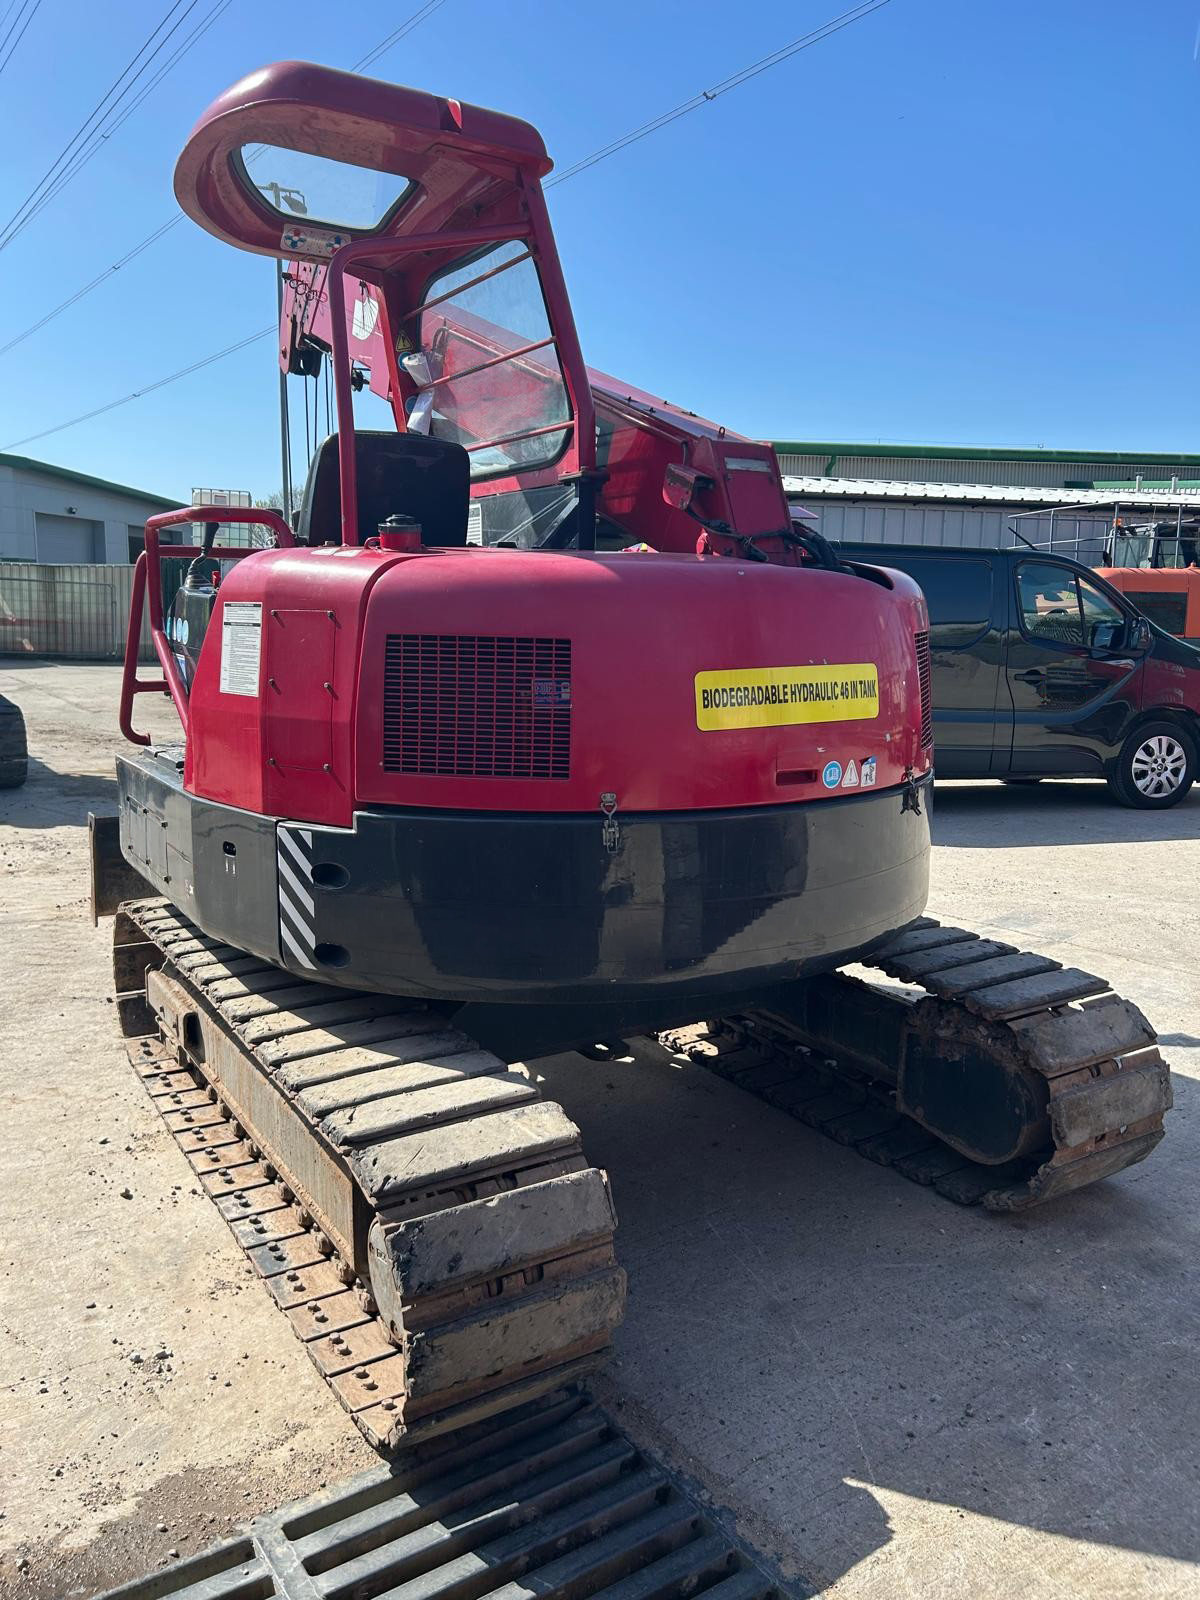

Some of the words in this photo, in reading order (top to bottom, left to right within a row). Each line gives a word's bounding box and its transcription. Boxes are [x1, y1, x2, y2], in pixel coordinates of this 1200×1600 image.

[702, 684, 789, 709] BIODEGRADABLE
[790, 681, 839, 703] HYDRAULIC
[840, 682, 849, 699] 46
[850, 680, 858, 699] IN
[859, 679, 877, 698] TANK
